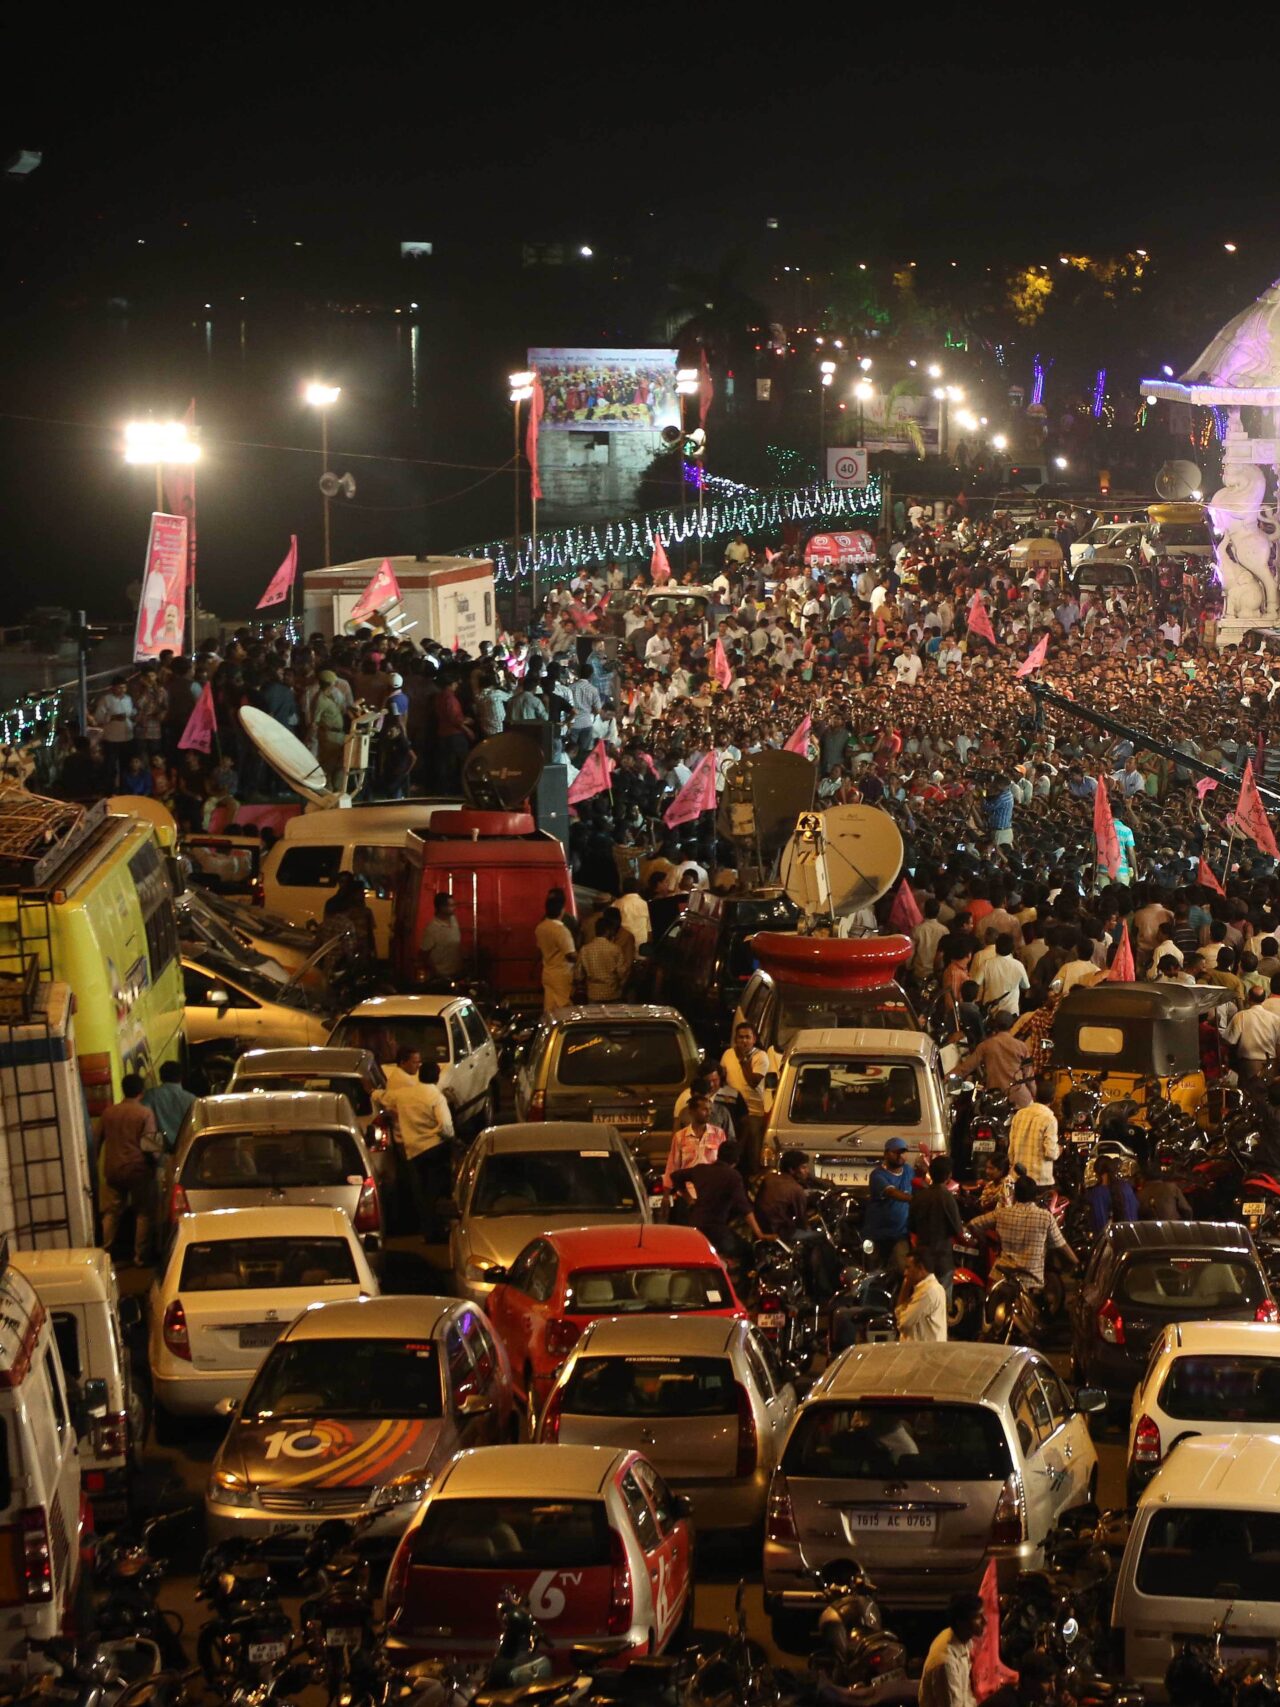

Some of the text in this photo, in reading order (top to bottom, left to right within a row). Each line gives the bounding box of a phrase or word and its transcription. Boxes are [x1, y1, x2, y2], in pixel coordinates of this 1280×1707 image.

[840, 463, 854, 474] 40
[264, 1430, 332, 1460] 10
[887, 1514, 900, 1526] AC
[907, 1514, 932, 1527] 0765
[529, 1570, 583, 1620] 6 TV
